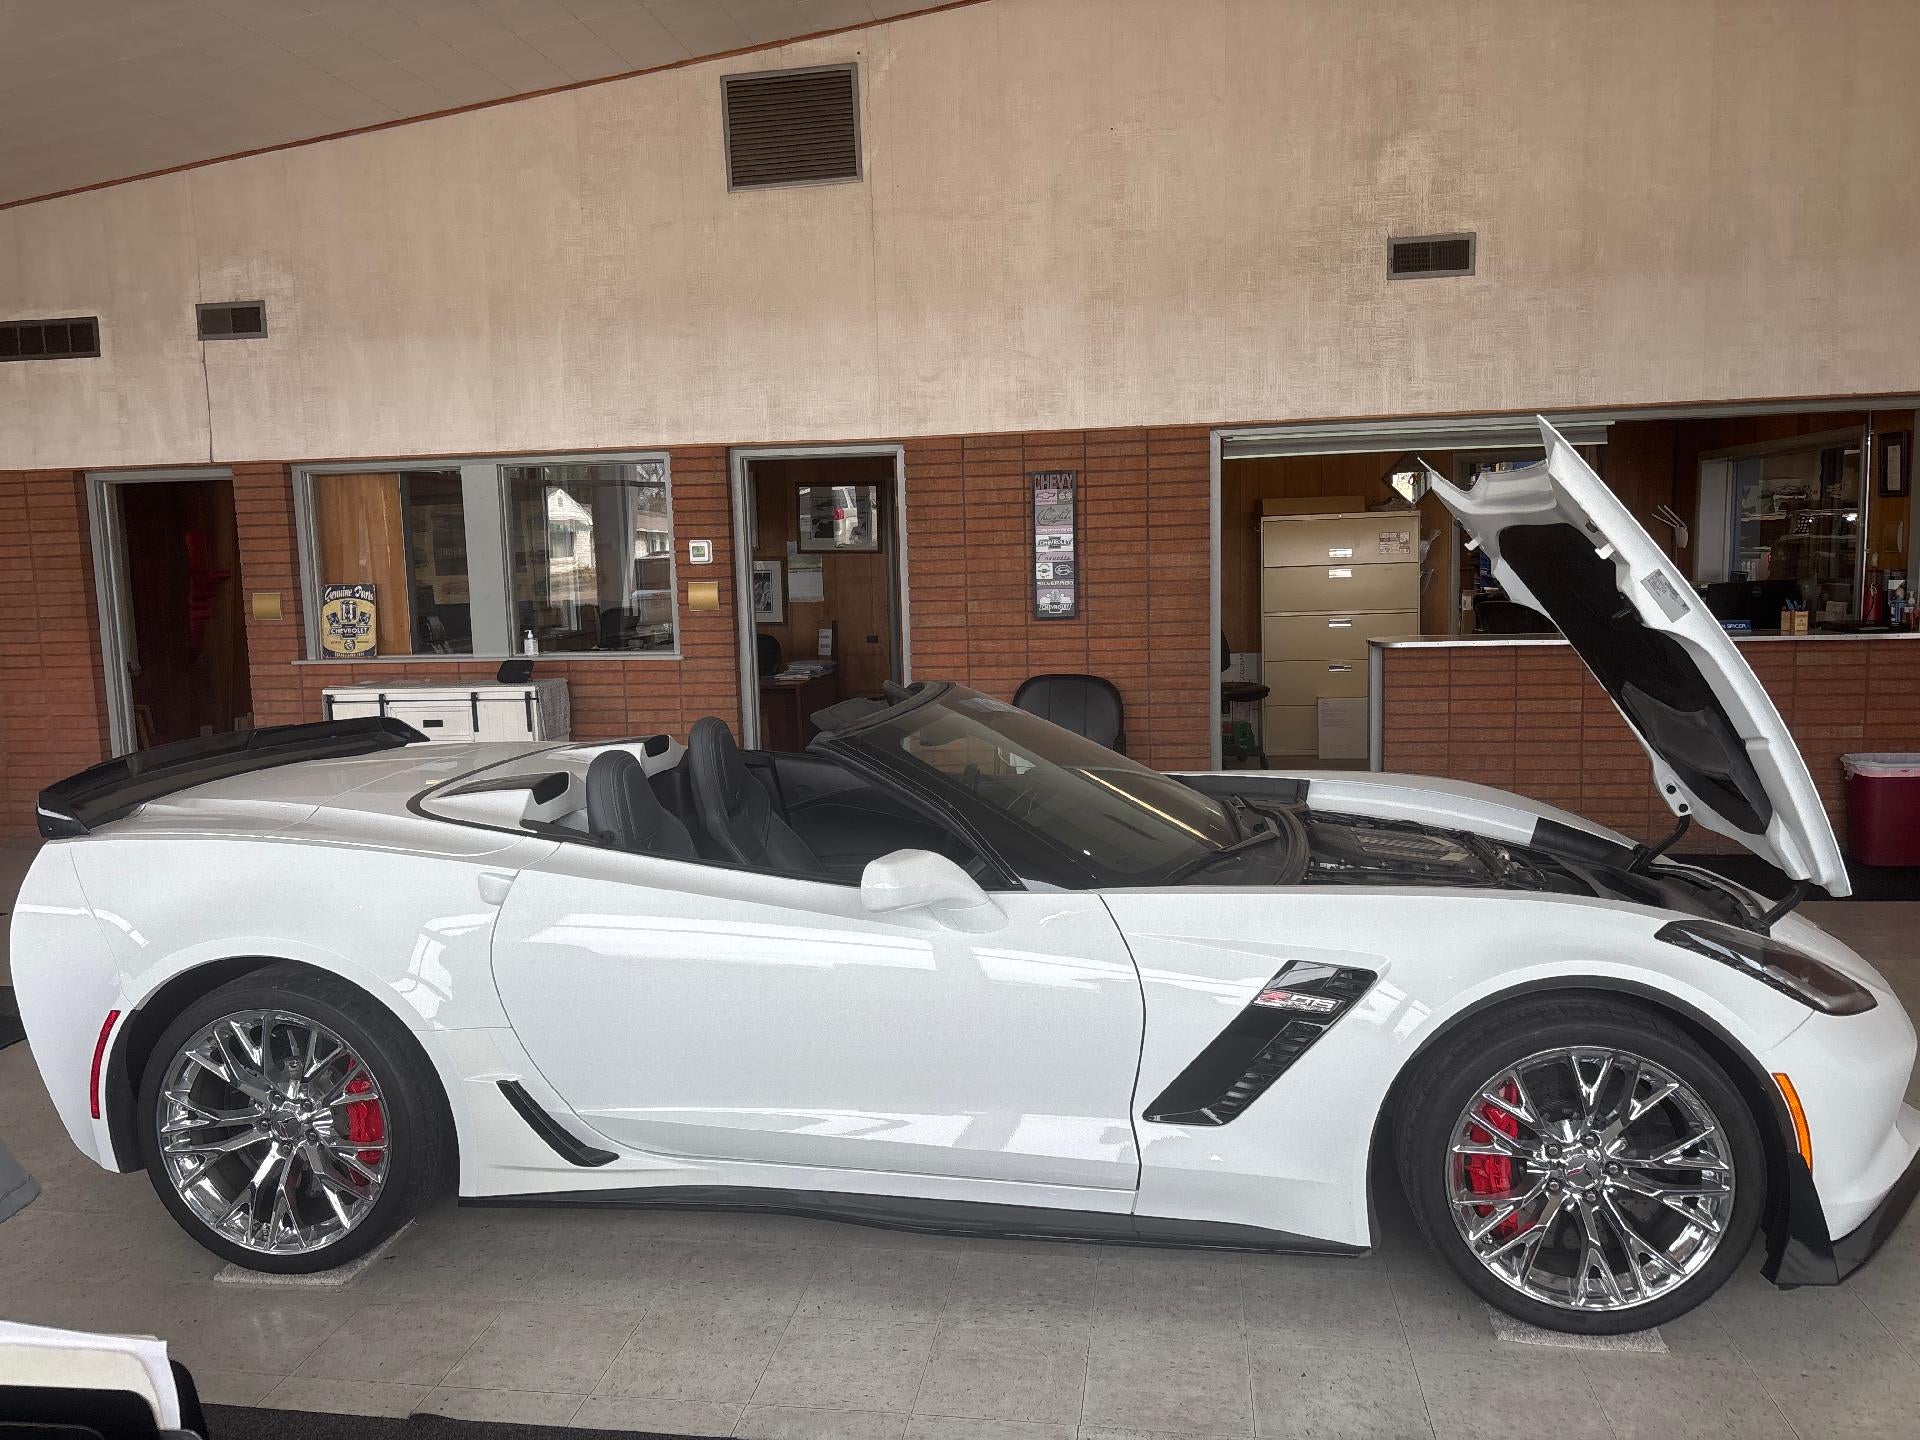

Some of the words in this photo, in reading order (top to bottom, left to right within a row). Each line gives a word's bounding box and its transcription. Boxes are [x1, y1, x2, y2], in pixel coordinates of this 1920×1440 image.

[1035, 473, 1072, 489] CHEVY
[325, 586, 352, 602] Genuine
[354, 585, 374, 601] Parts
